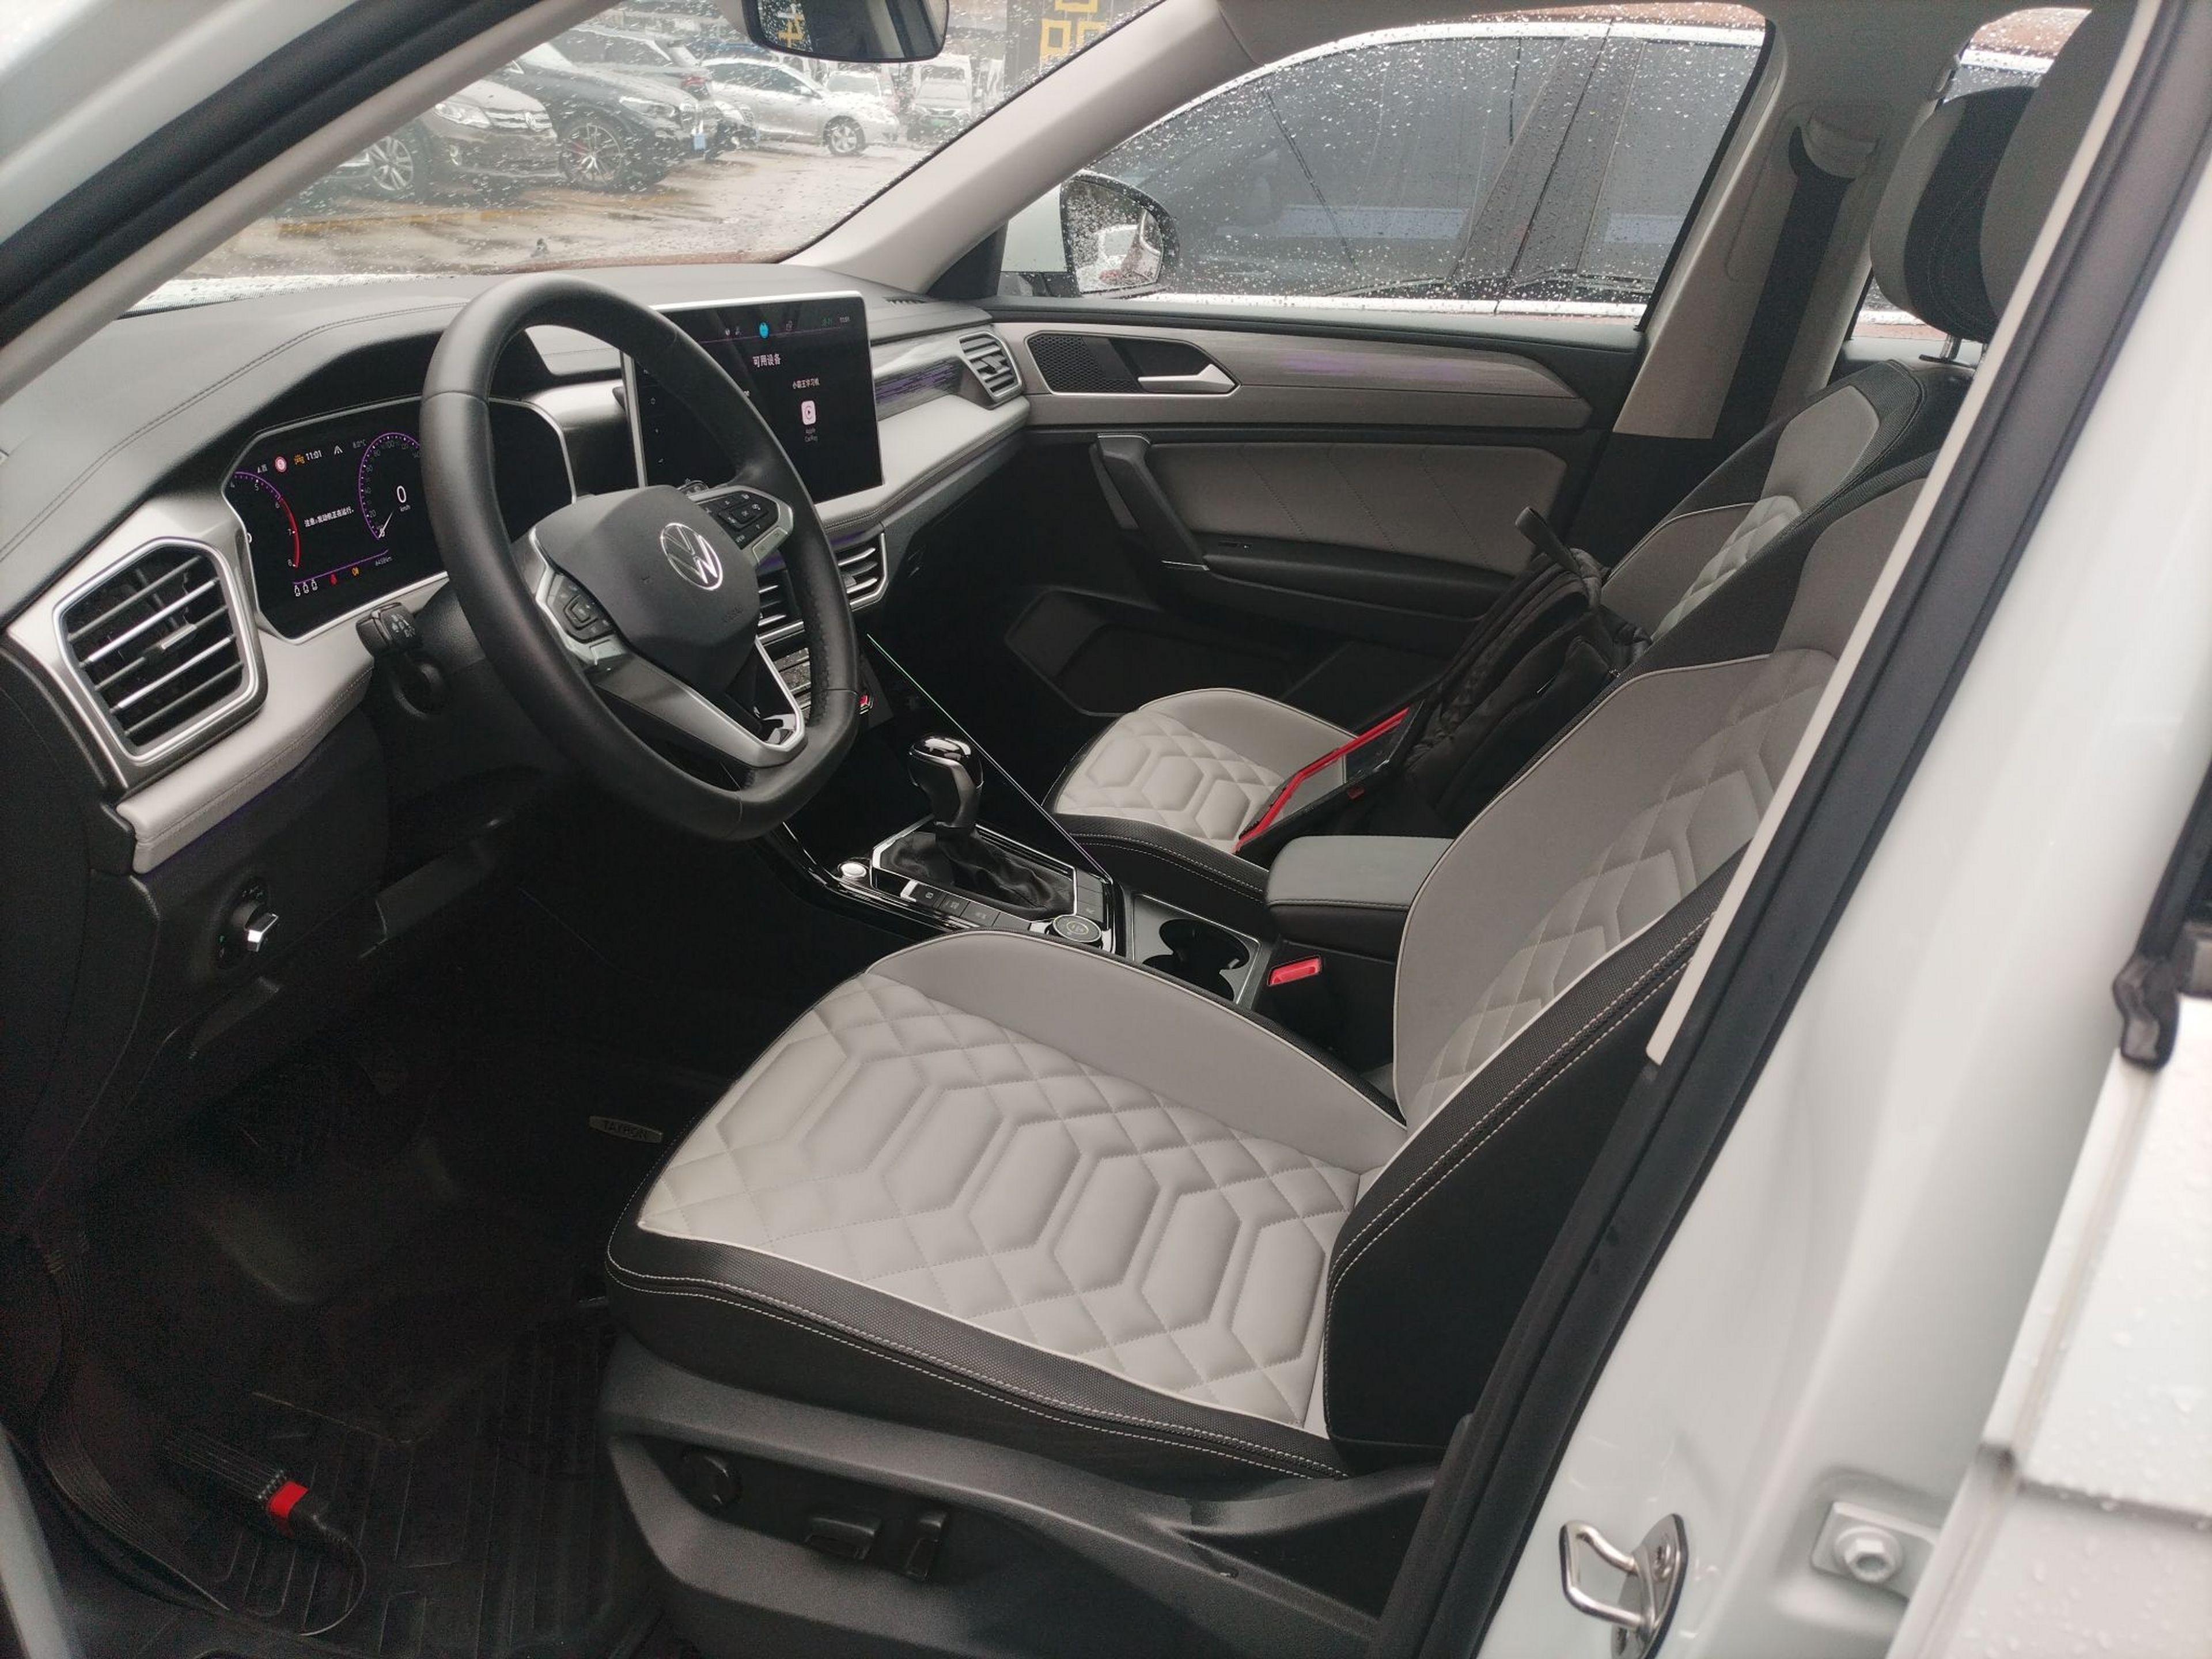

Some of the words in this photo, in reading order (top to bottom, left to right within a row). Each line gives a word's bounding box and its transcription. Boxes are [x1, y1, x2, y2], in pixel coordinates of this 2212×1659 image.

[752, 353, 781, 368] 可用设备
[305, 449, 322, 461] 11:01
[254, 483, 259, 491] 5
[396, 485, 407, 503] 0
